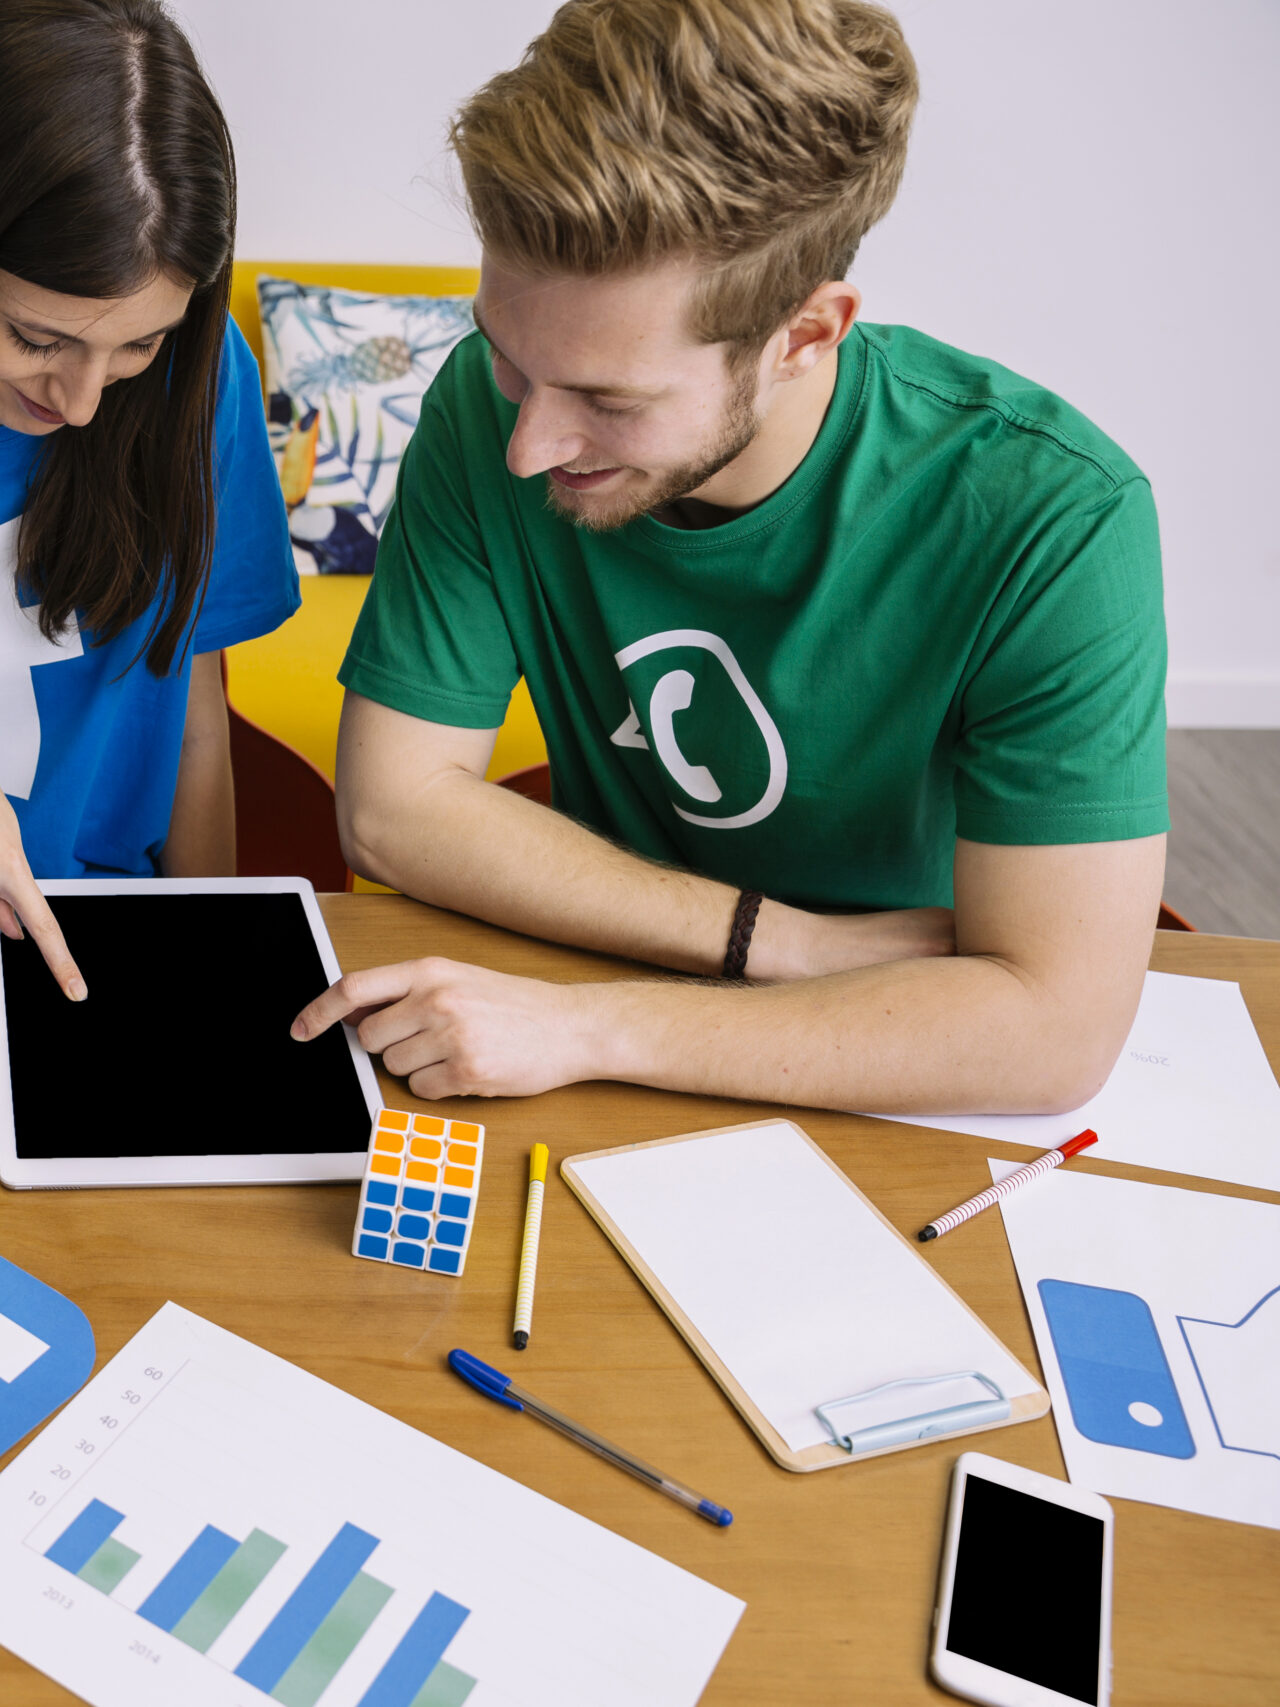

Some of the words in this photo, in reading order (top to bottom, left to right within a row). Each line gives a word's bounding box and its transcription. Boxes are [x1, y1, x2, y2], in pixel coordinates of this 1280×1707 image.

[144, 1366, 163, 1381] 60
[120, 1389, 142, 1406] 50
[99, 1415, 119, 1430] 40
[74, 1438, 96, 1455] 30
[49, 1463, 72, 1481] 20
[27, 1490, 48, 1507] 10
[42, 1585, 75, 1611] 2013
[128, 1639, 162, 1664] 2014
